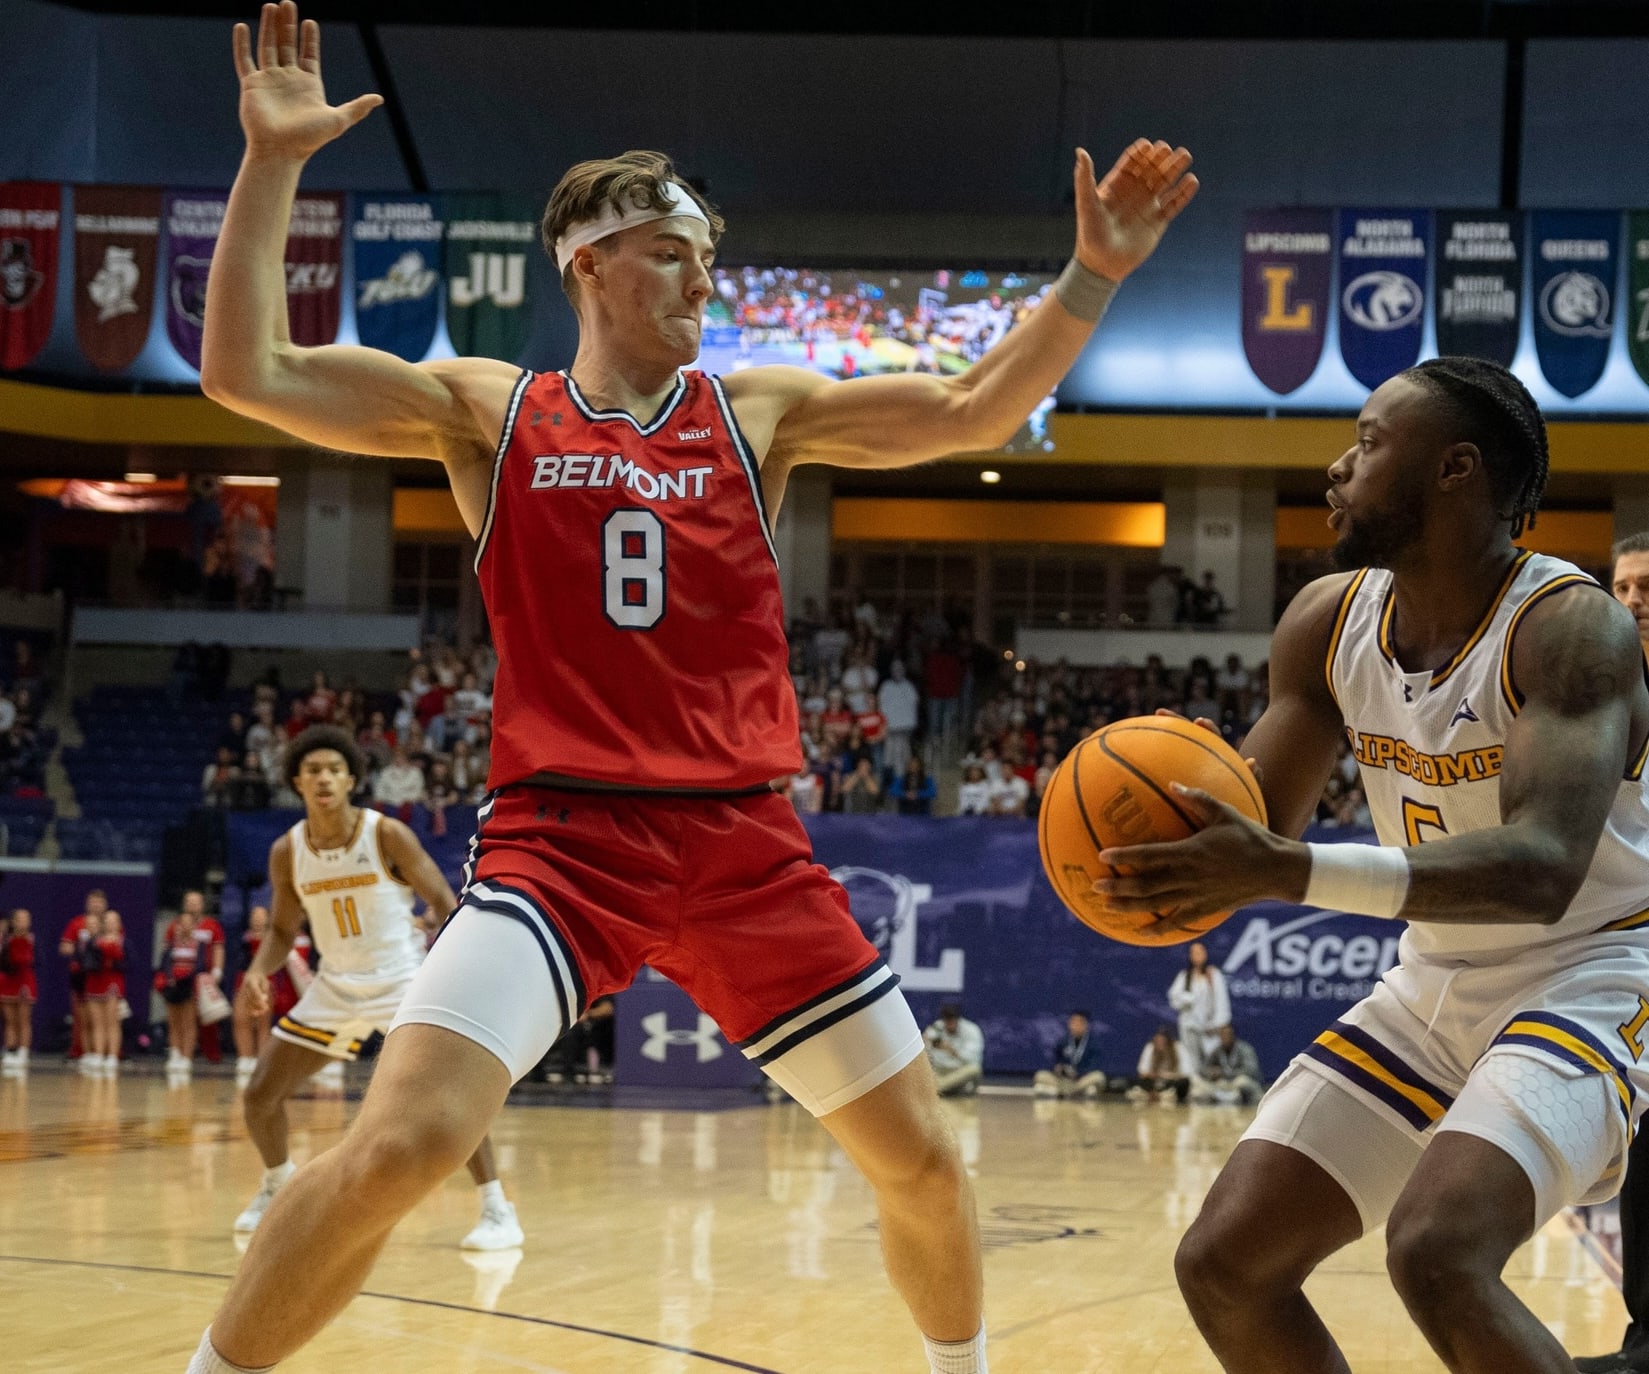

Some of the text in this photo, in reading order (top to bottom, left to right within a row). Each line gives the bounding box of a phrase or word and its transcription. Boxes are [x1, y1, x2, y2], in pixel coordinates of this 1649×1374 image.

[452, 254, 526, 306] JU
[1260, 266, 1314, 331] L
[678, 426, 711, 441] VALLEY
[530, 453, 713, 500] BELMONT
[602, 507, 667, 631] 8
[332, 896, 362, 938] 11
[1229, 976, 1373, 1001] ederal Credi
